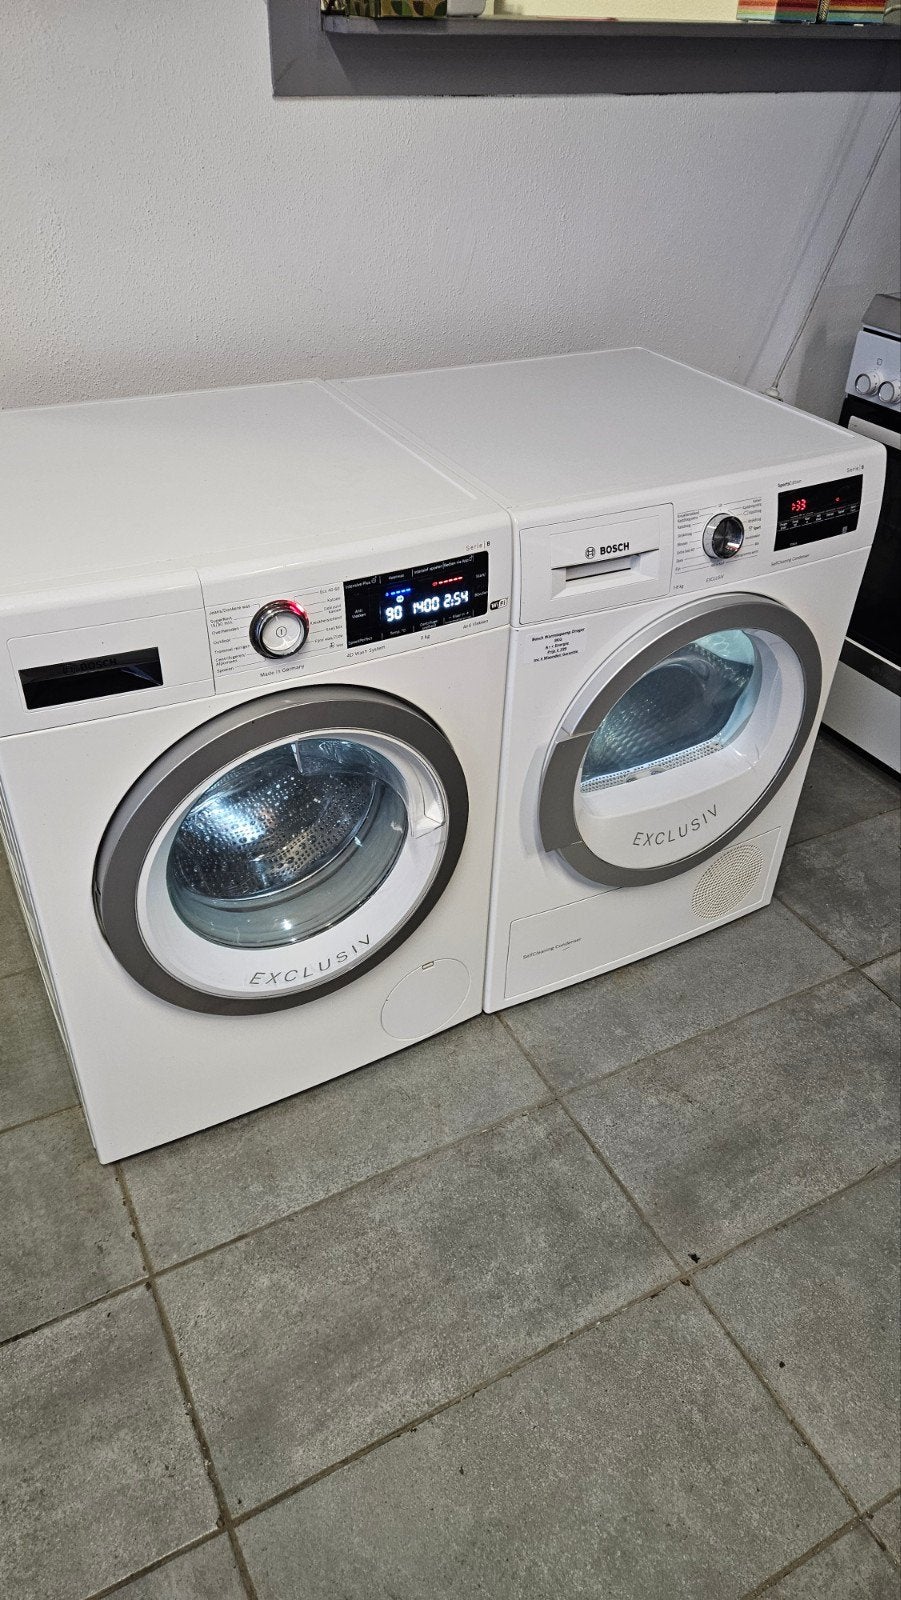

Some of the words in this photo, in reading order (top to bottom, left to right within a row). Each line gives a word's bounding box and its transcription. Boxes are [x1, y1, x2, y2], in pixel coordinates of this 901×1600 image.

[466, 543, 483, 551] Serie
[600, 542, 630, 555] BOSCH
[412, 596, 440, 614] 1400
[443, 590, 469, 608] 2:54
[385, 605, 403, 622] 90
[369, 645, 386, 653] System
[82, 657, 118, 672] BOSCH
[281, 664, 305, 673] Germany
[632, 804, 718, 846] EXCLUSIV
[249, 934, 373, 985] EXCLUSIV
